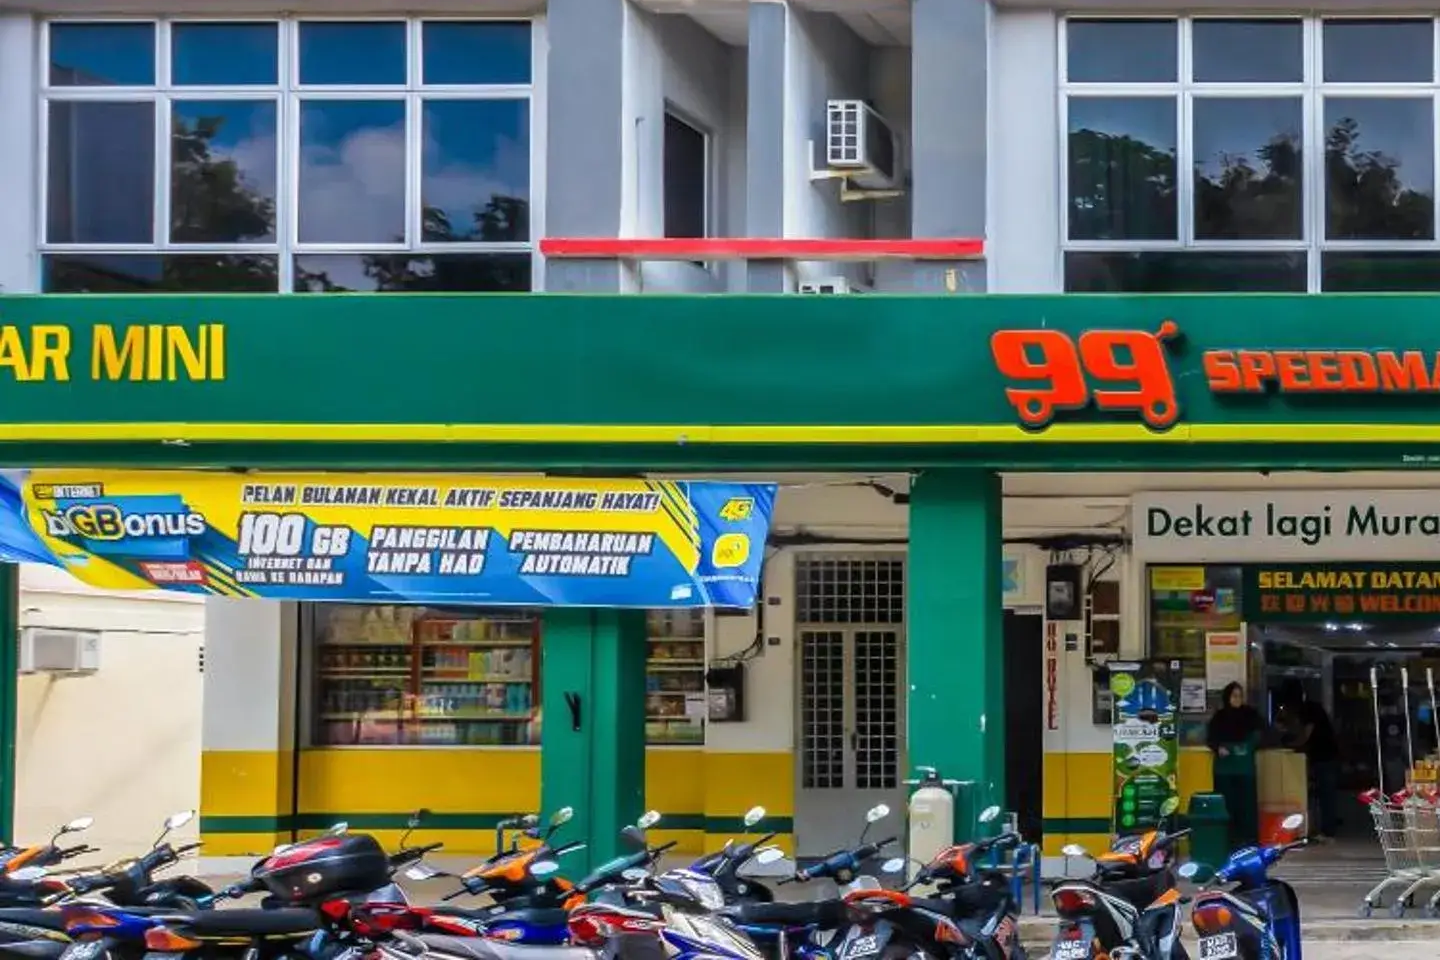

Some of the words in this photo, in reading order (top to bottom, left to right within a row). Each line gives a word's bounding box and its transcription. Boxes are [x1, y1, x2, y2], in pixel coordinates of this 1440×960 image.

[91, 324, 225, 381] MINI
[991, 319, 1182, 427] 99
[243, 485, 295, 504] PELAN
[302, 487, 383, 505] BULANAN
[385, 489, 439, 506] KEKAL
[445, 490, 496, 507] AKTIF
[500, 490, 598, 509] SEPANJANG
[601, 493, 660, 511] HAYAT!
[238, 513, 305, 556] 100
[312, 527, 351, 556] GB
[1147, 504, 1252, 537] Dekat
[1267, 503, 1332, 544] lagi
[370, 527, 489, 551] PANGGILAN
[509, 531, 653, 554] PEMBAHARUAN
[367, 553, 431, 573] TANPA
[438, 554, 485, 575] HAD
[521, 555, 630, 576] AUTOMATIK
[1259, 571, 1366, 588] SELAMAT
